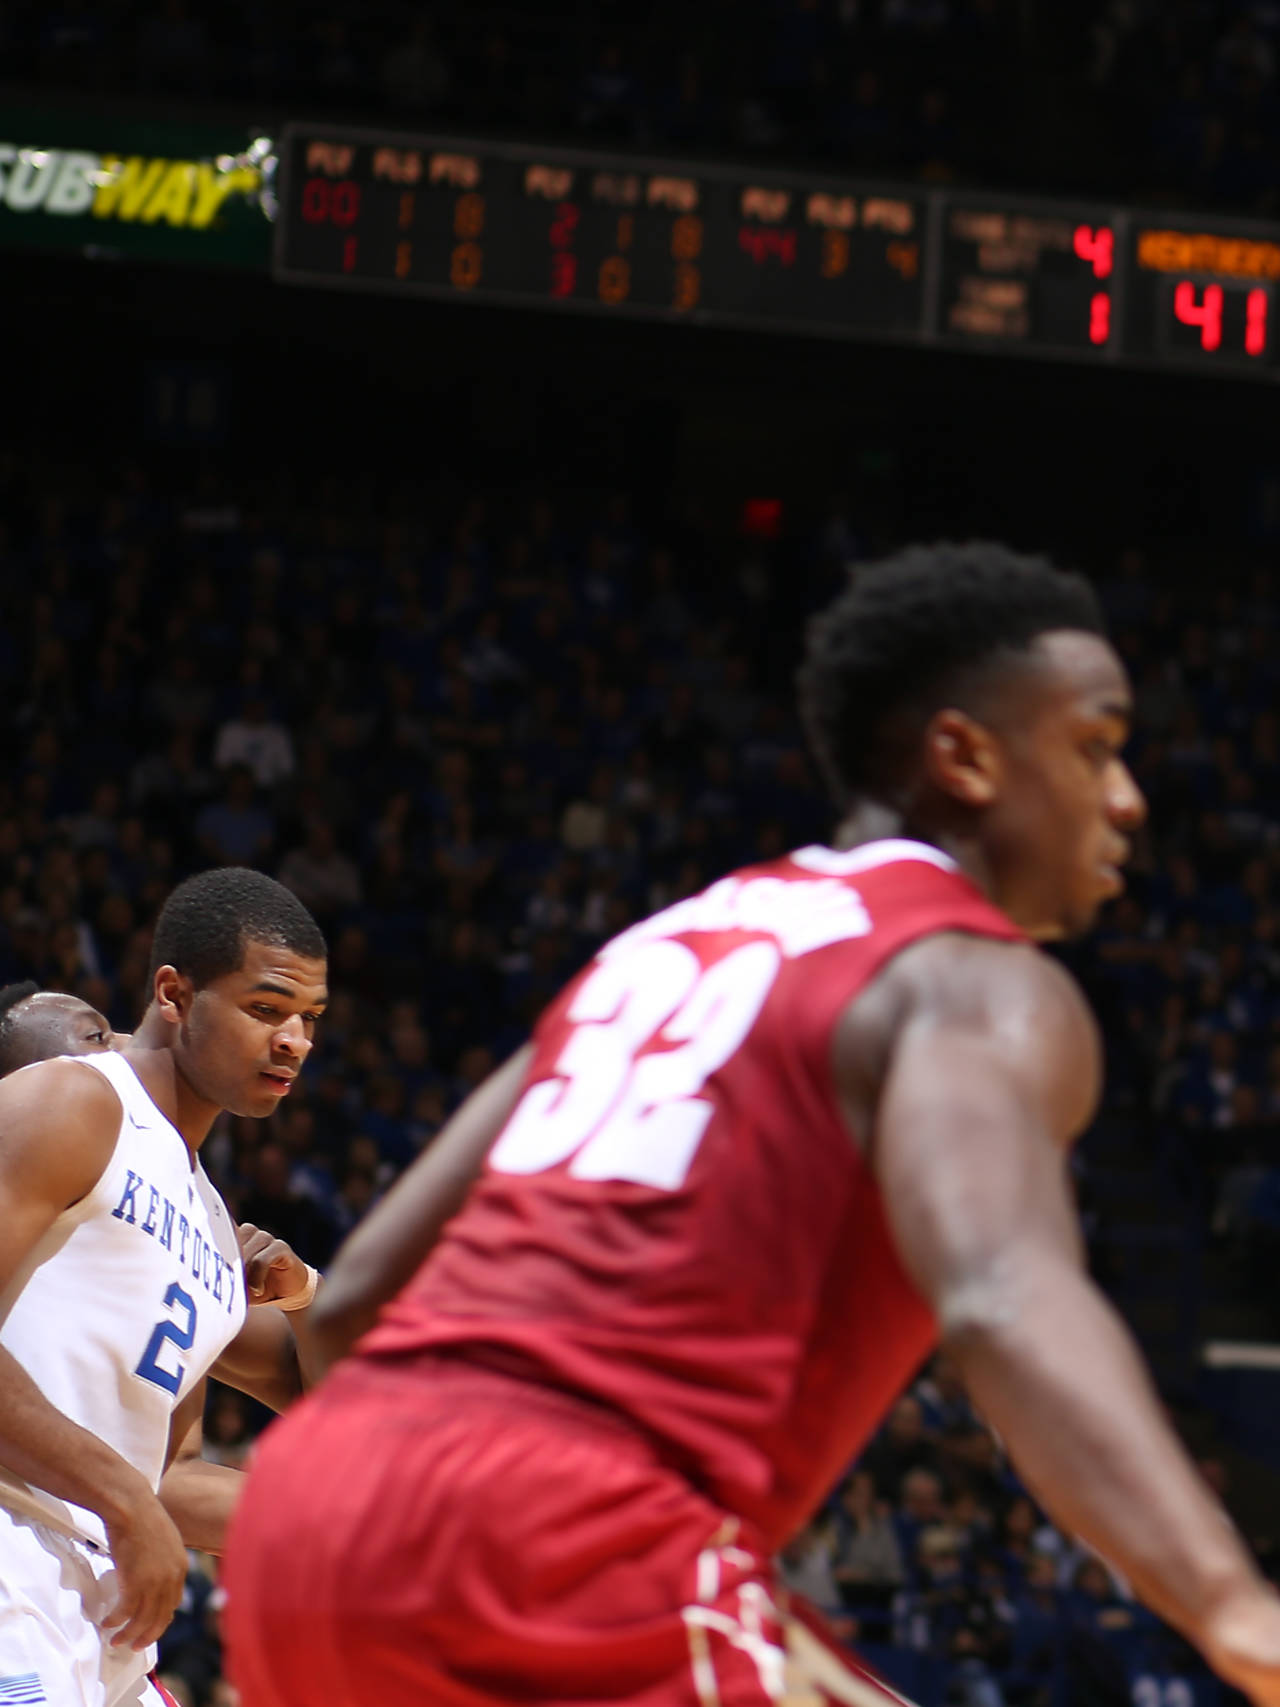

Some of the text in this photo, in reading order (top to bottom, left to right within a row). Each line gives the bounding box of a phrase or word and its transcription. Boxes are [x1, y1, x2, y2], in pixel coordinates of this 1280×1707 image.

[1073, 224, 1114, 279] 4
[1089, 291, 1111, 345] 1
[1174, 280, 1268, 356] 41
[488, 938, 783, 1192] 32
[111, 1168, 236, 1315] KENTUCKY
[132, 1280, 199, 1397] 2
